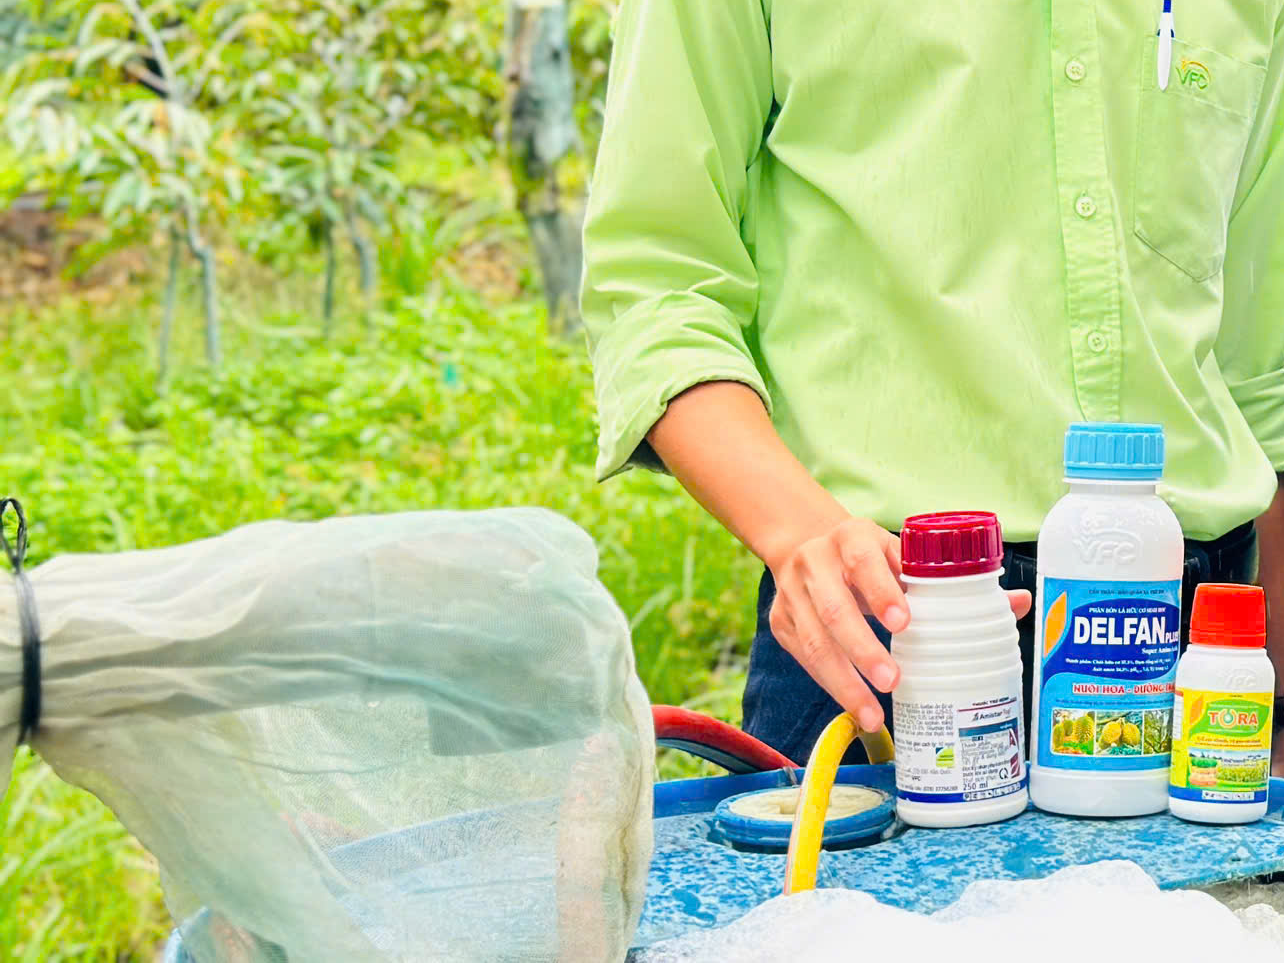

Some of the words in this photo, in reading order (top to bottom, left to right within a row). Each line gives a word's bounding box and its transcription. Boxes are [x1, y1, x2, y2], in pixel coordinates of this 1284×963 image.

[1175, 67, 1208, 90] VFC
[1072, 540, 1136, 564] VFC
[1073, 616, 1166, 645] DELFAN
[1103, 685, 1125, 693] HOA
[1208, 708, 1258, 728] TORA
